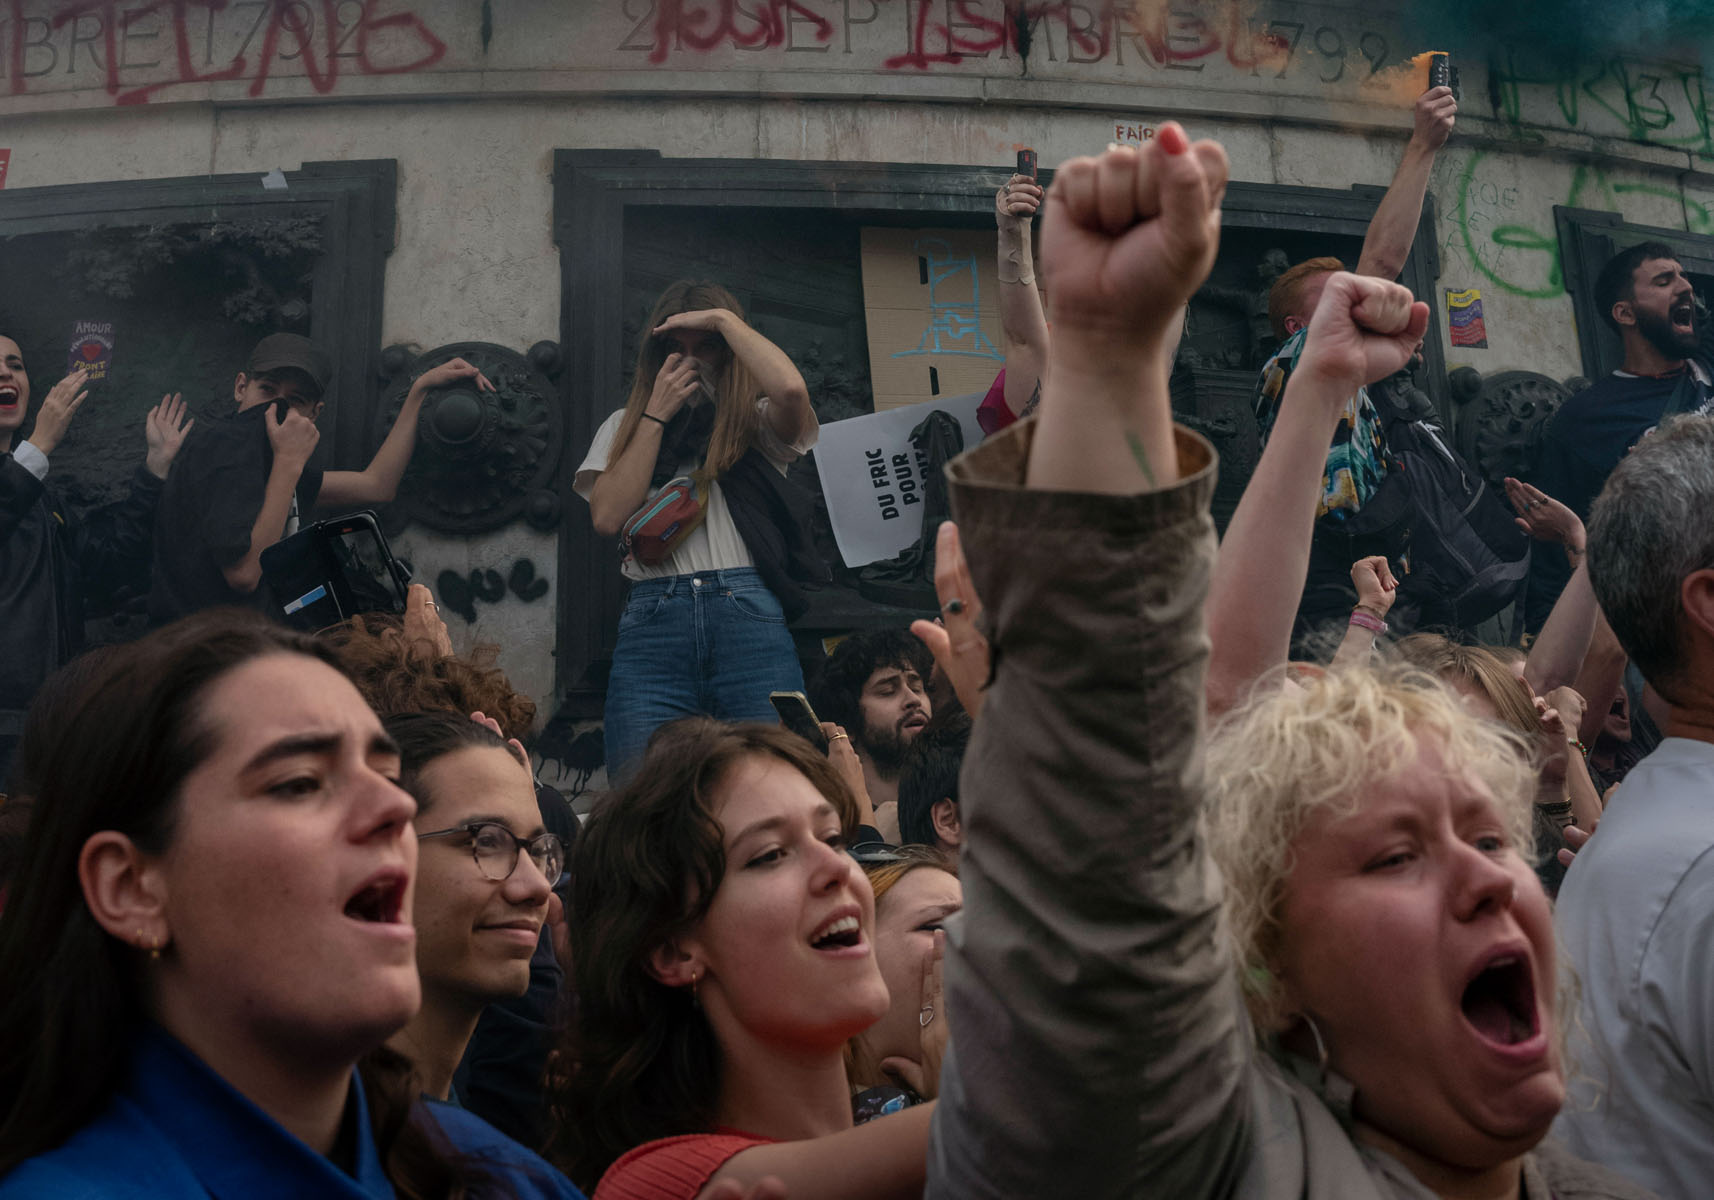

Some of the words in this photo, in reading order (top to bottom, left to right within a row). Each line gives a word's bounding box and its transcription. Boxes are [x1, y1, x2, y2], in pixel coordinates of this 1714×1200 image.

[0, 7, 161, 79] BRE
[75, 322, 112, 334] AMOUR
[865, 447, 890, 489] FRIC
[892, 452, 921, 506] POUR
[878, 493, 900, 521] DU
